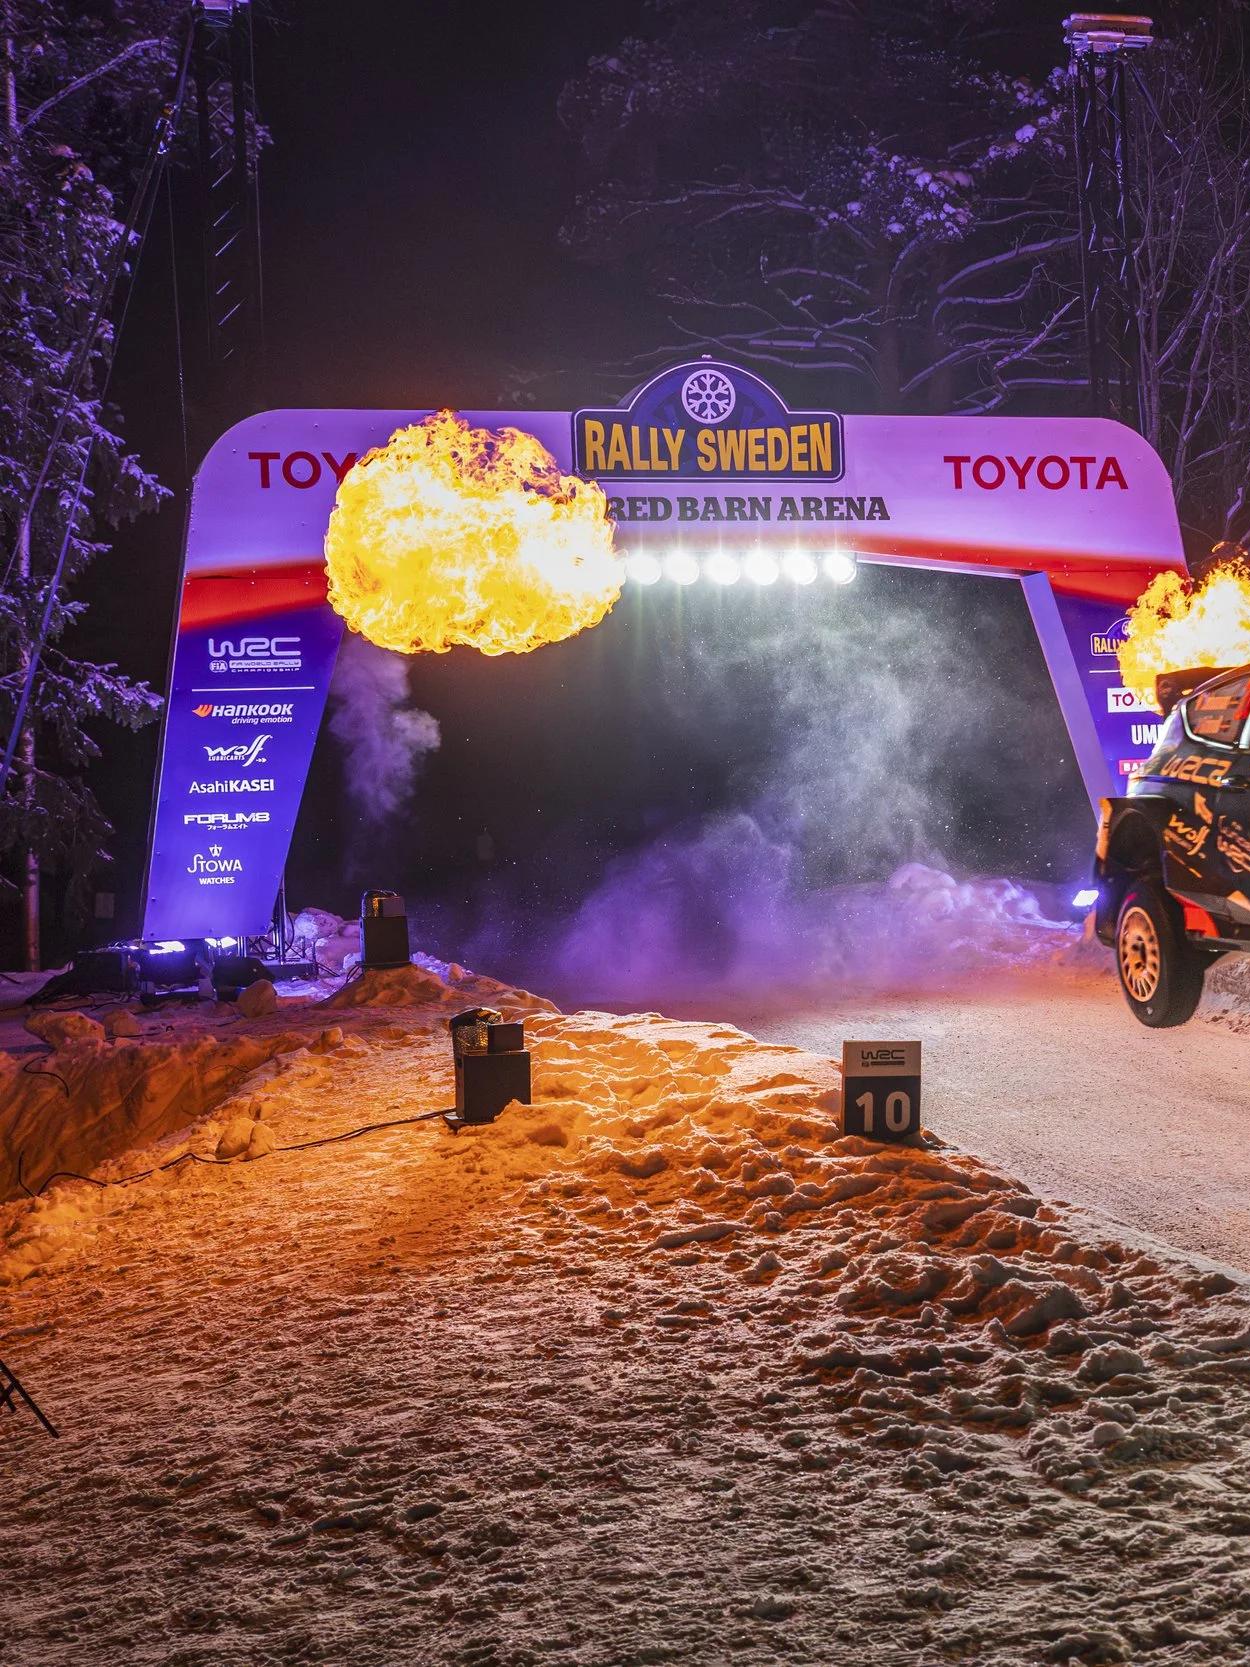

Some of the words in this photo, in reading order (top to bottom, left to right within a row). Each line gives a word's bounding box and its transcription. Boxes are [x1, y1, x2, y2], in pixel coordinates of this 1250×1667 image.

[584, 419, 685, 471] RALLY
[696, 421, 832, 472] SWEDEN
[943, 455, 1129, 490] TOYOTA
[608, 497, 672, 520] RED
[677, 497, 774, 521] BARN
[777, 497, 890, 521] ARENA
[208, 637, 301, 658] WRC
[231, 718, 259, 726] driving
[188, 779, 275, 794] AsahiKASEI
[184, 812, 270, 825] FORUM8
[187, 854, 243, 873] STOWA
[199, 876, 235, 885] WATCHES
[861, 1050, 905, 1060] WRC
[856, 1091, 911, 1132] 10
